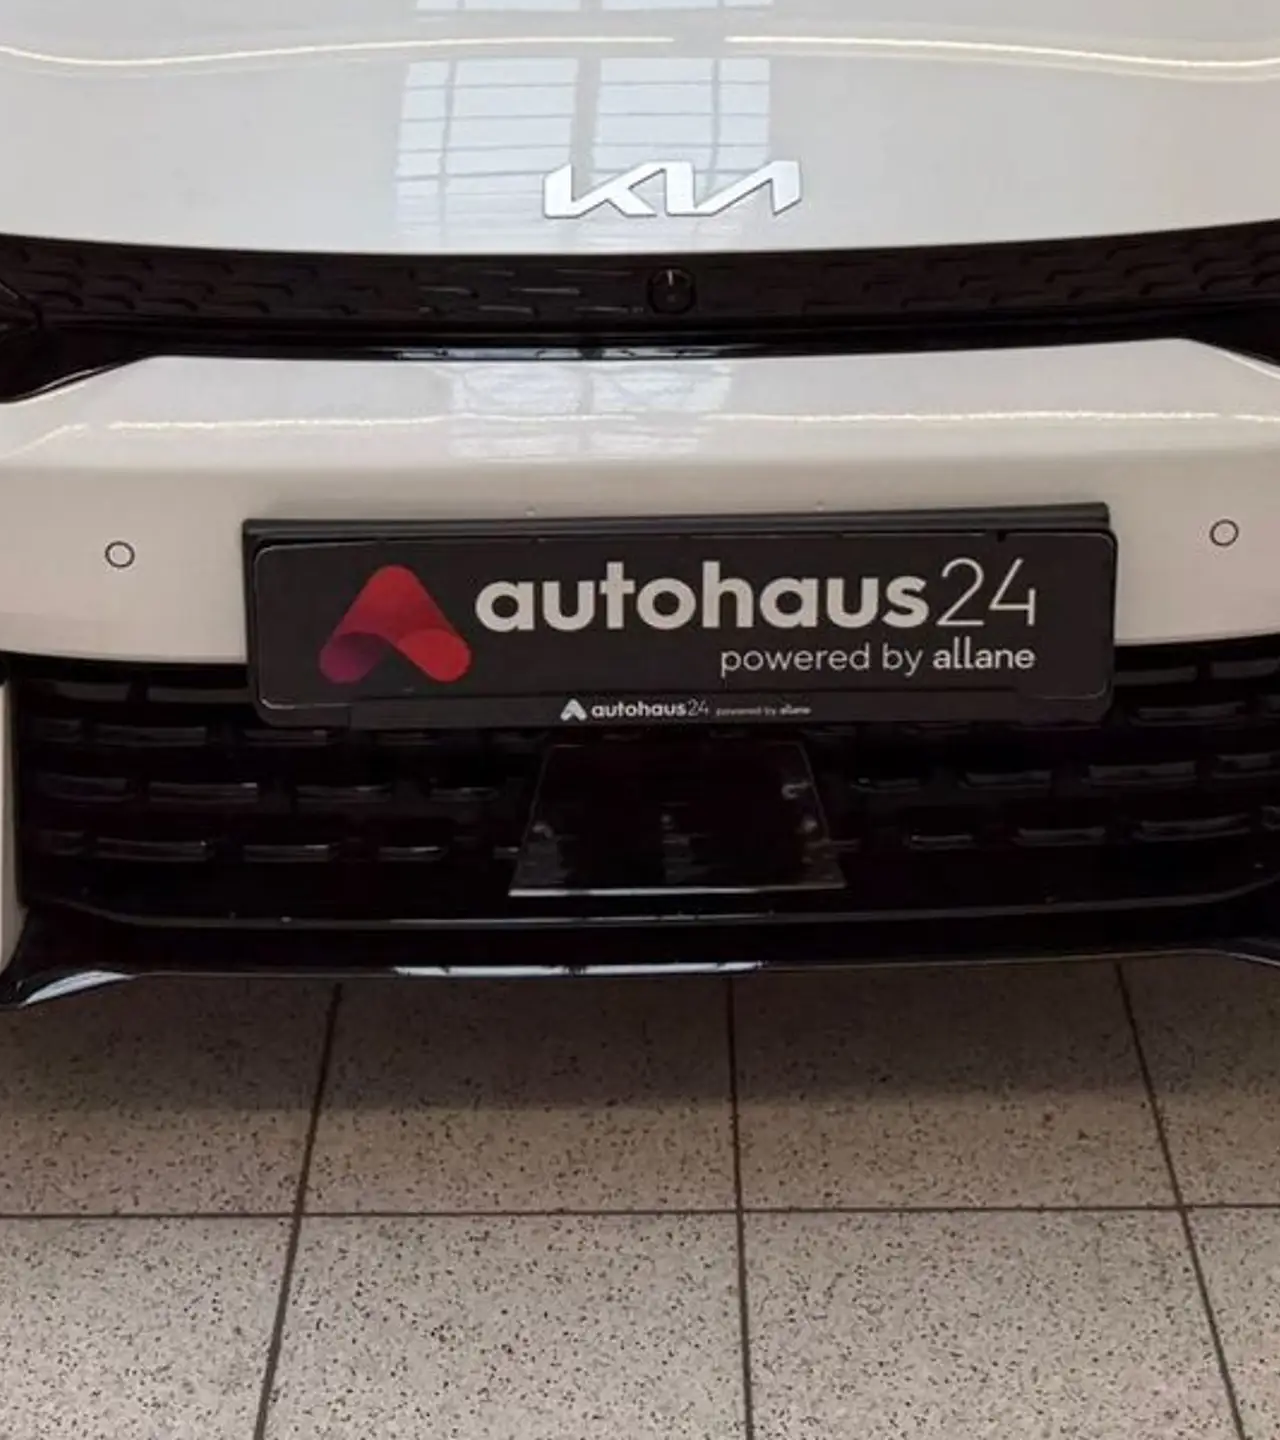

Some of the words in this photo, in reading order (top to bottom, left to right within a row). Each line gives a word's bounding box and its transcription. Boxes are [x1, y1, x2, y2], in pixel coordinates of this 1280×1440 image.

[475, 558, 1036, 631] autohaus24
[721, 643, 870, 678] powered
[883, 643, 923, 677] by
[932, 636, 1036, 669] allane
[590, 698, 709, 717] autohaus24
